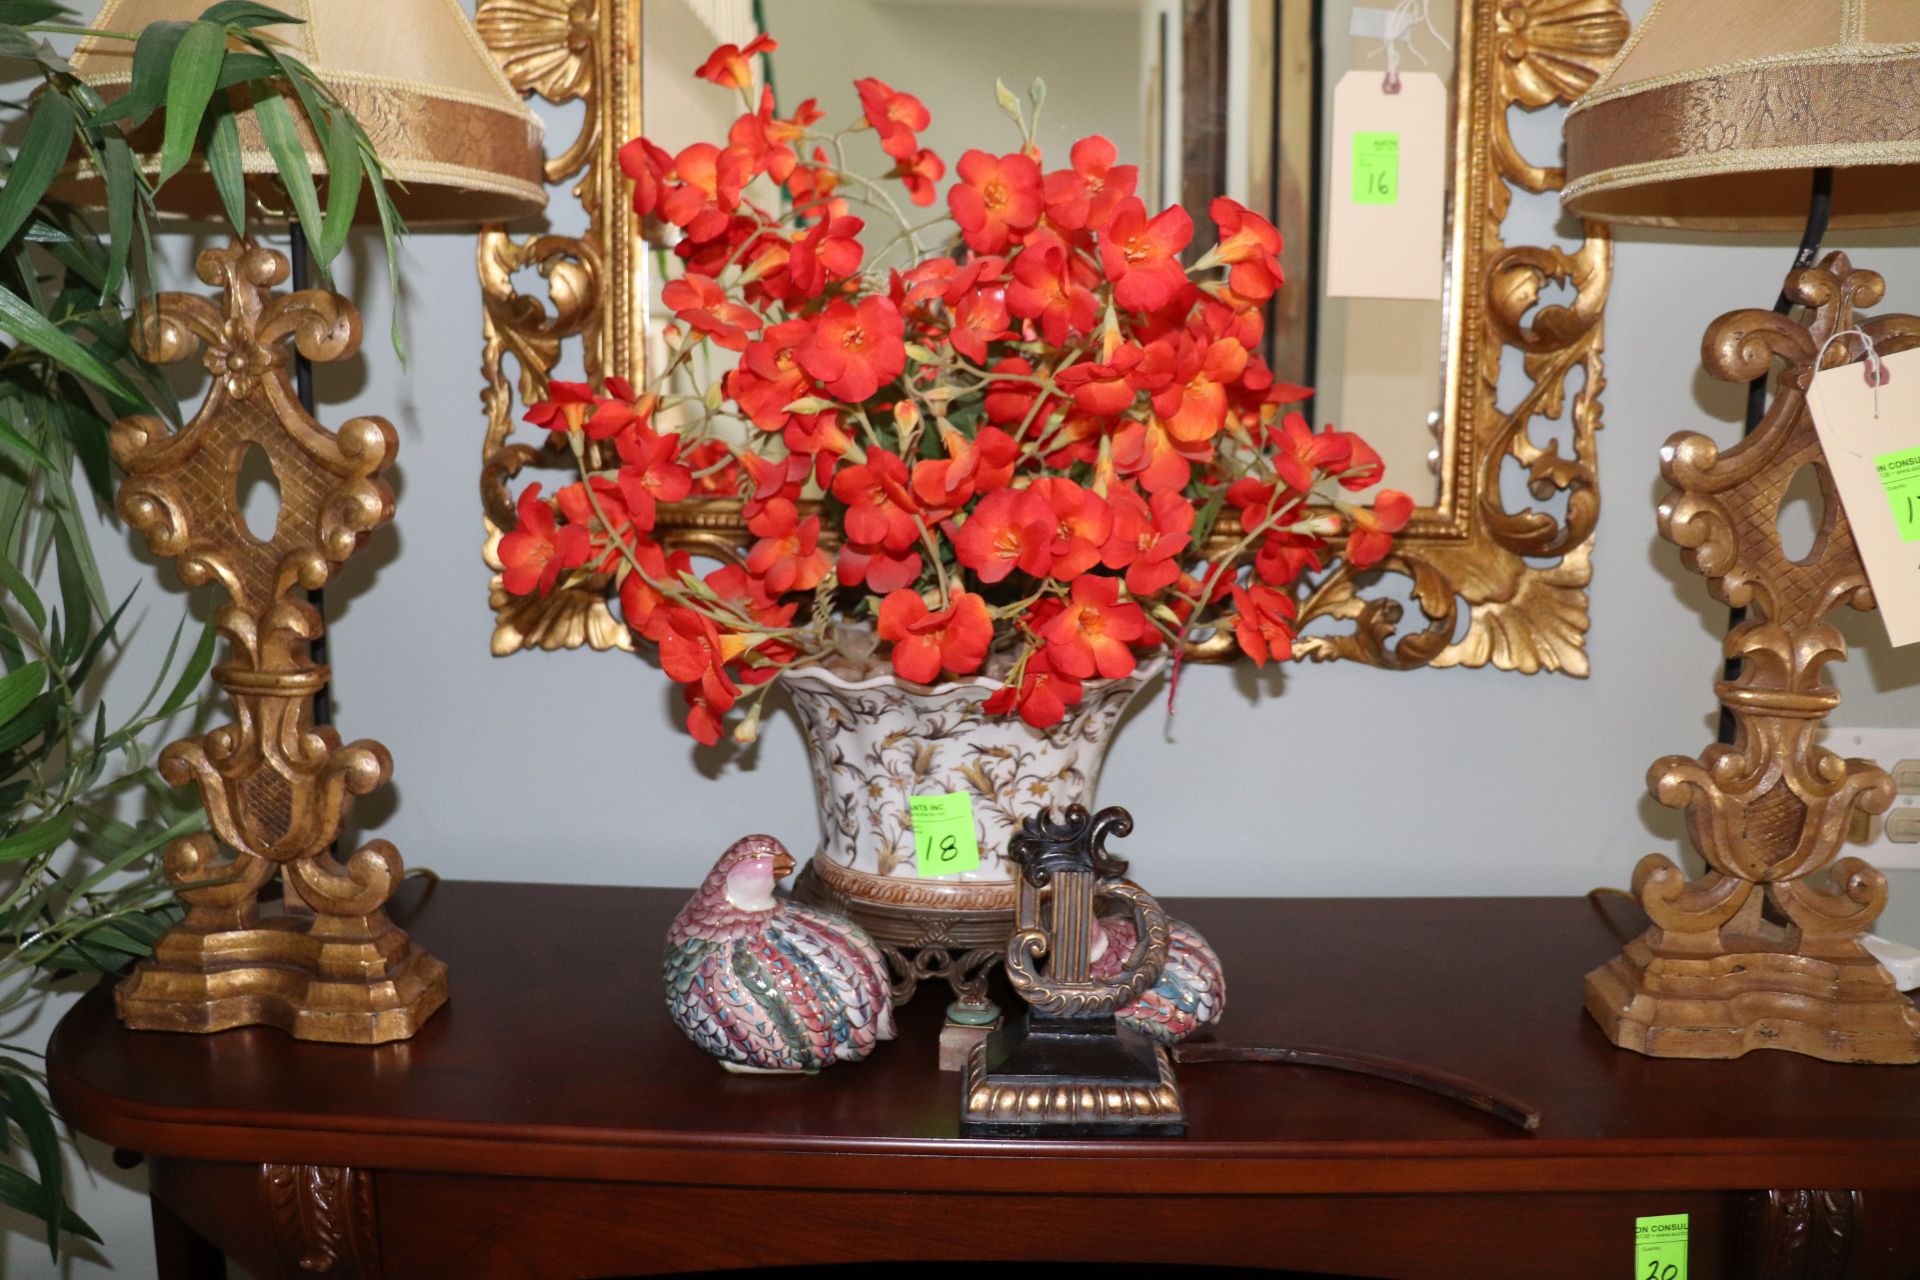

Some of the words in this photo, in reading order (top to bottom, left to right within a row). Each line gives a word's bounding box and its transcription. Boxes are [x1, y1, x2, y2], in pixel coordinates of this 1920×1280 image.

[1368, 171, 1389, 195] 16
[1907, 495, 1920, 524] 1
[926, 834, 959, 861] 18
[1651, 1223, 1688, 1232] CONSUL
[1646, 1260, 1678, 1280] 20
